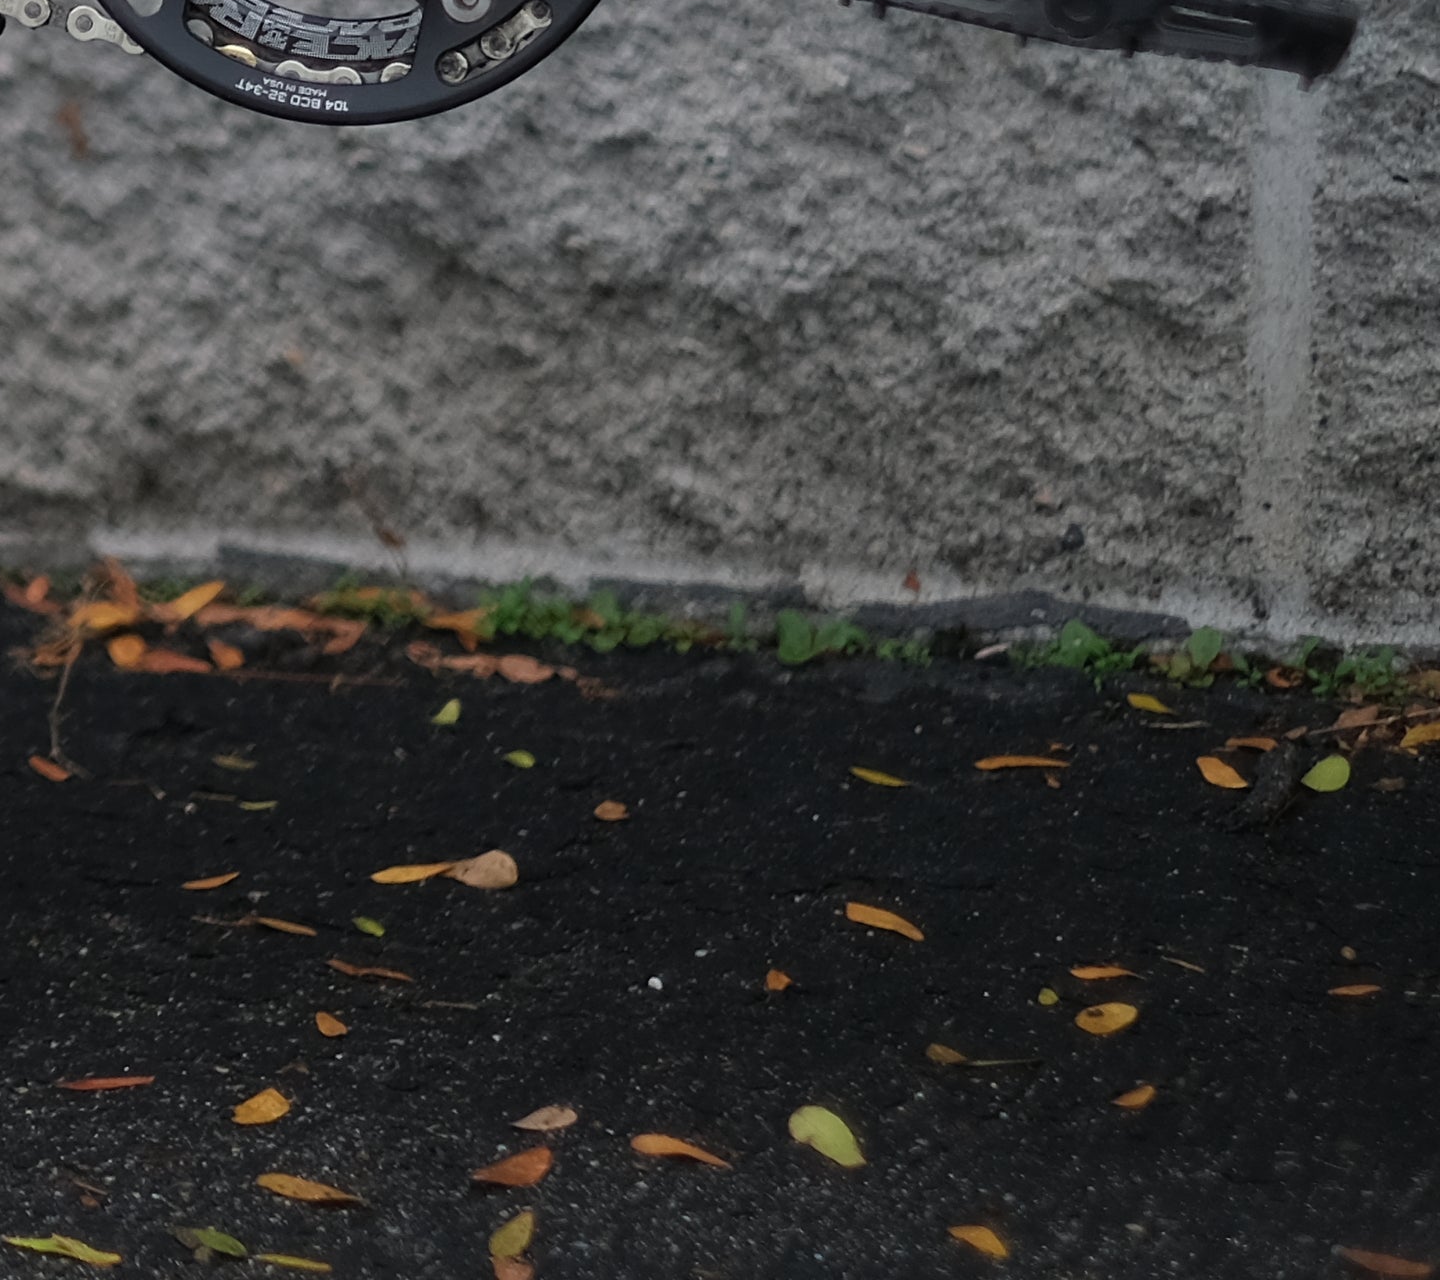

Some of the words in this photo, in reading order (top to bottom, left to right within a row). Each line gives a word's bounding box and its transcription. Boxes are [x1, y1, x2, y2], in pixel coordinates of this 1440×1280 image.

[262, 76, 284, 89] USA
[285, 83, 296, 92] IN
[235, 78, 288, 103] 32-34T
[298, 86, 327, 97] MADE
[290, 94, 321, 110] BCD
[325, 99, 349, 112] 104
